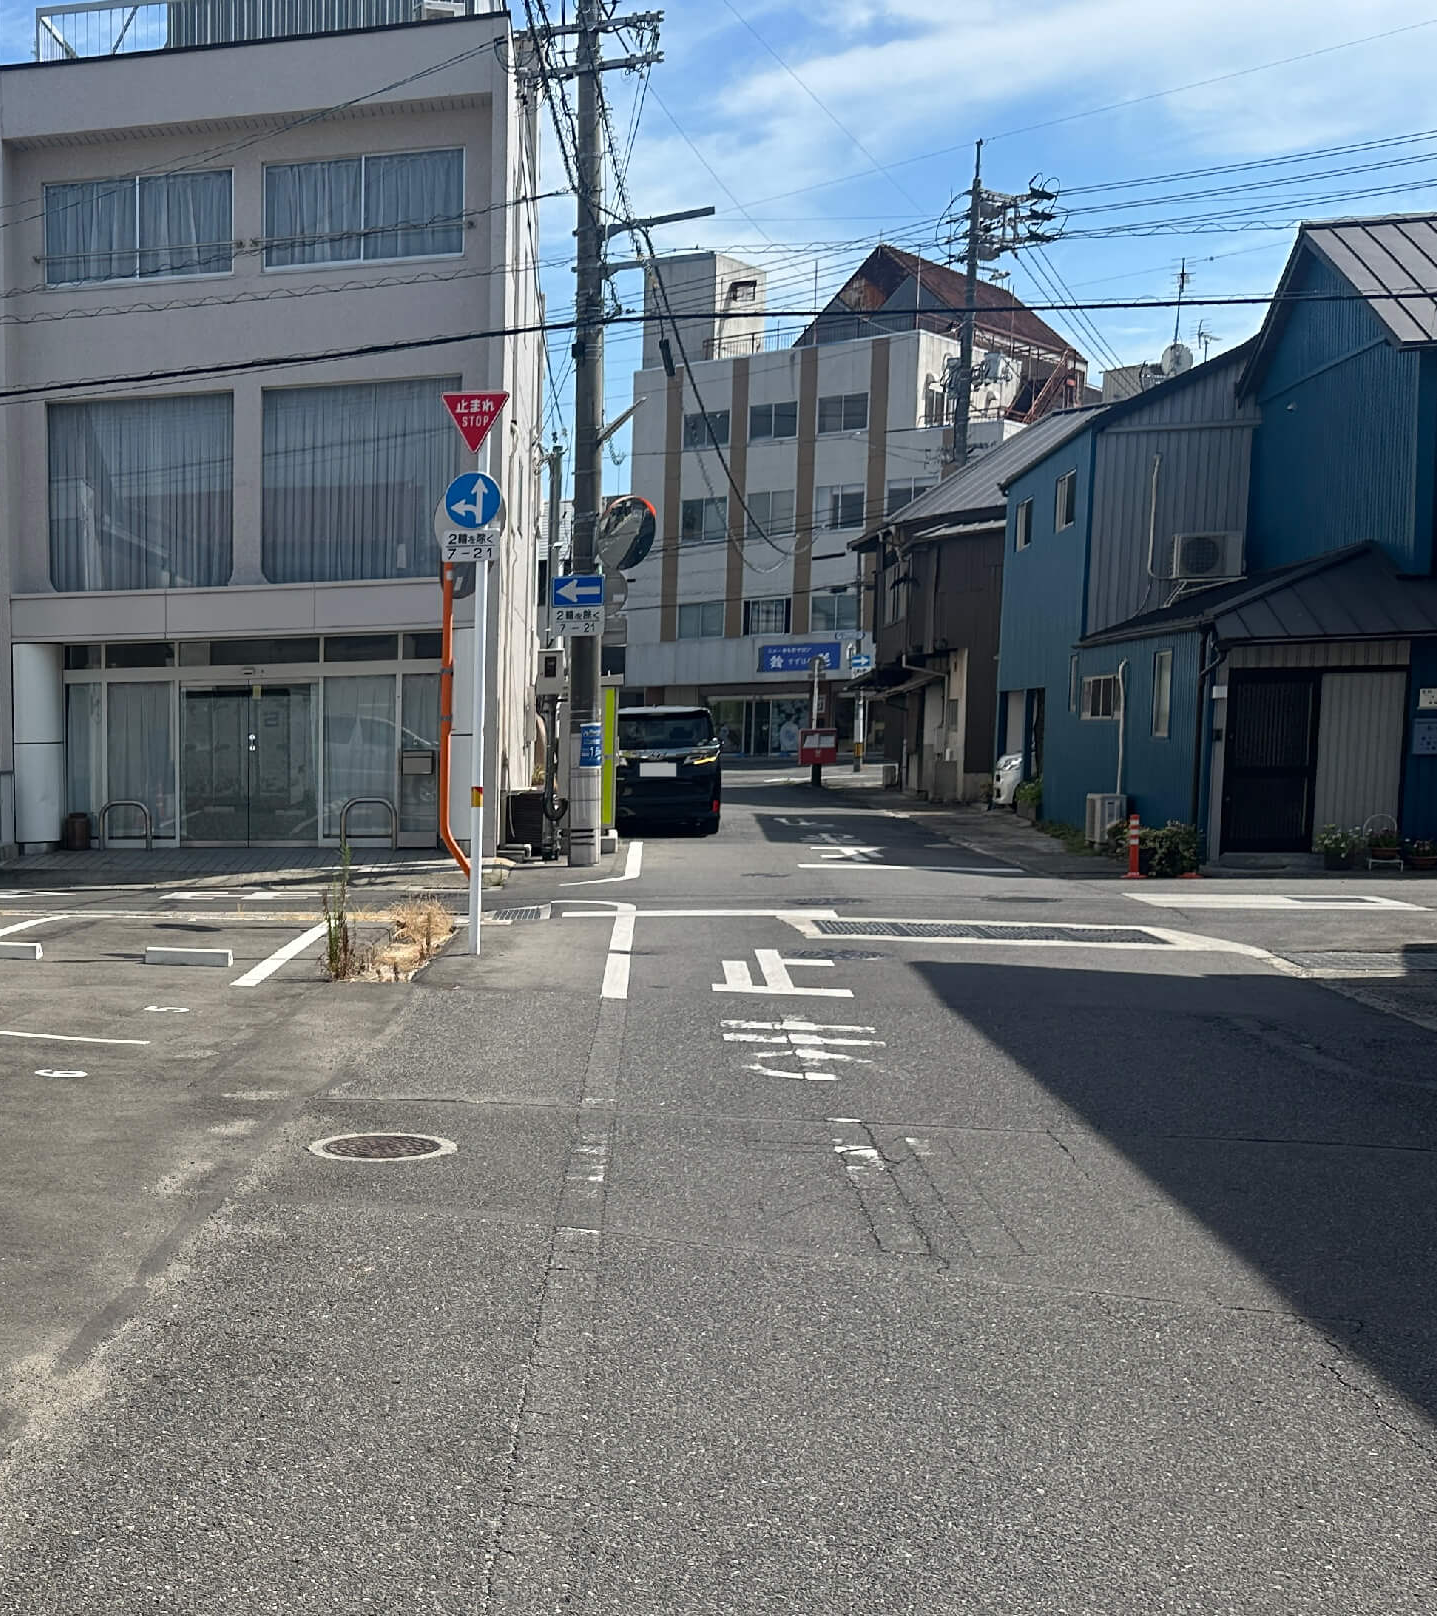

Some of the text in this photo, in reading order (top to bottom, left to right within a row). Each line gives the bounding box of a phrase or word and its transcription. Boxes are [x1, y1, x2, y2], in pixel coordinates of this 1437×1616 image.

[455, 398, 495, 414] 止まれ
[461, 415, 490, 428] STOP
